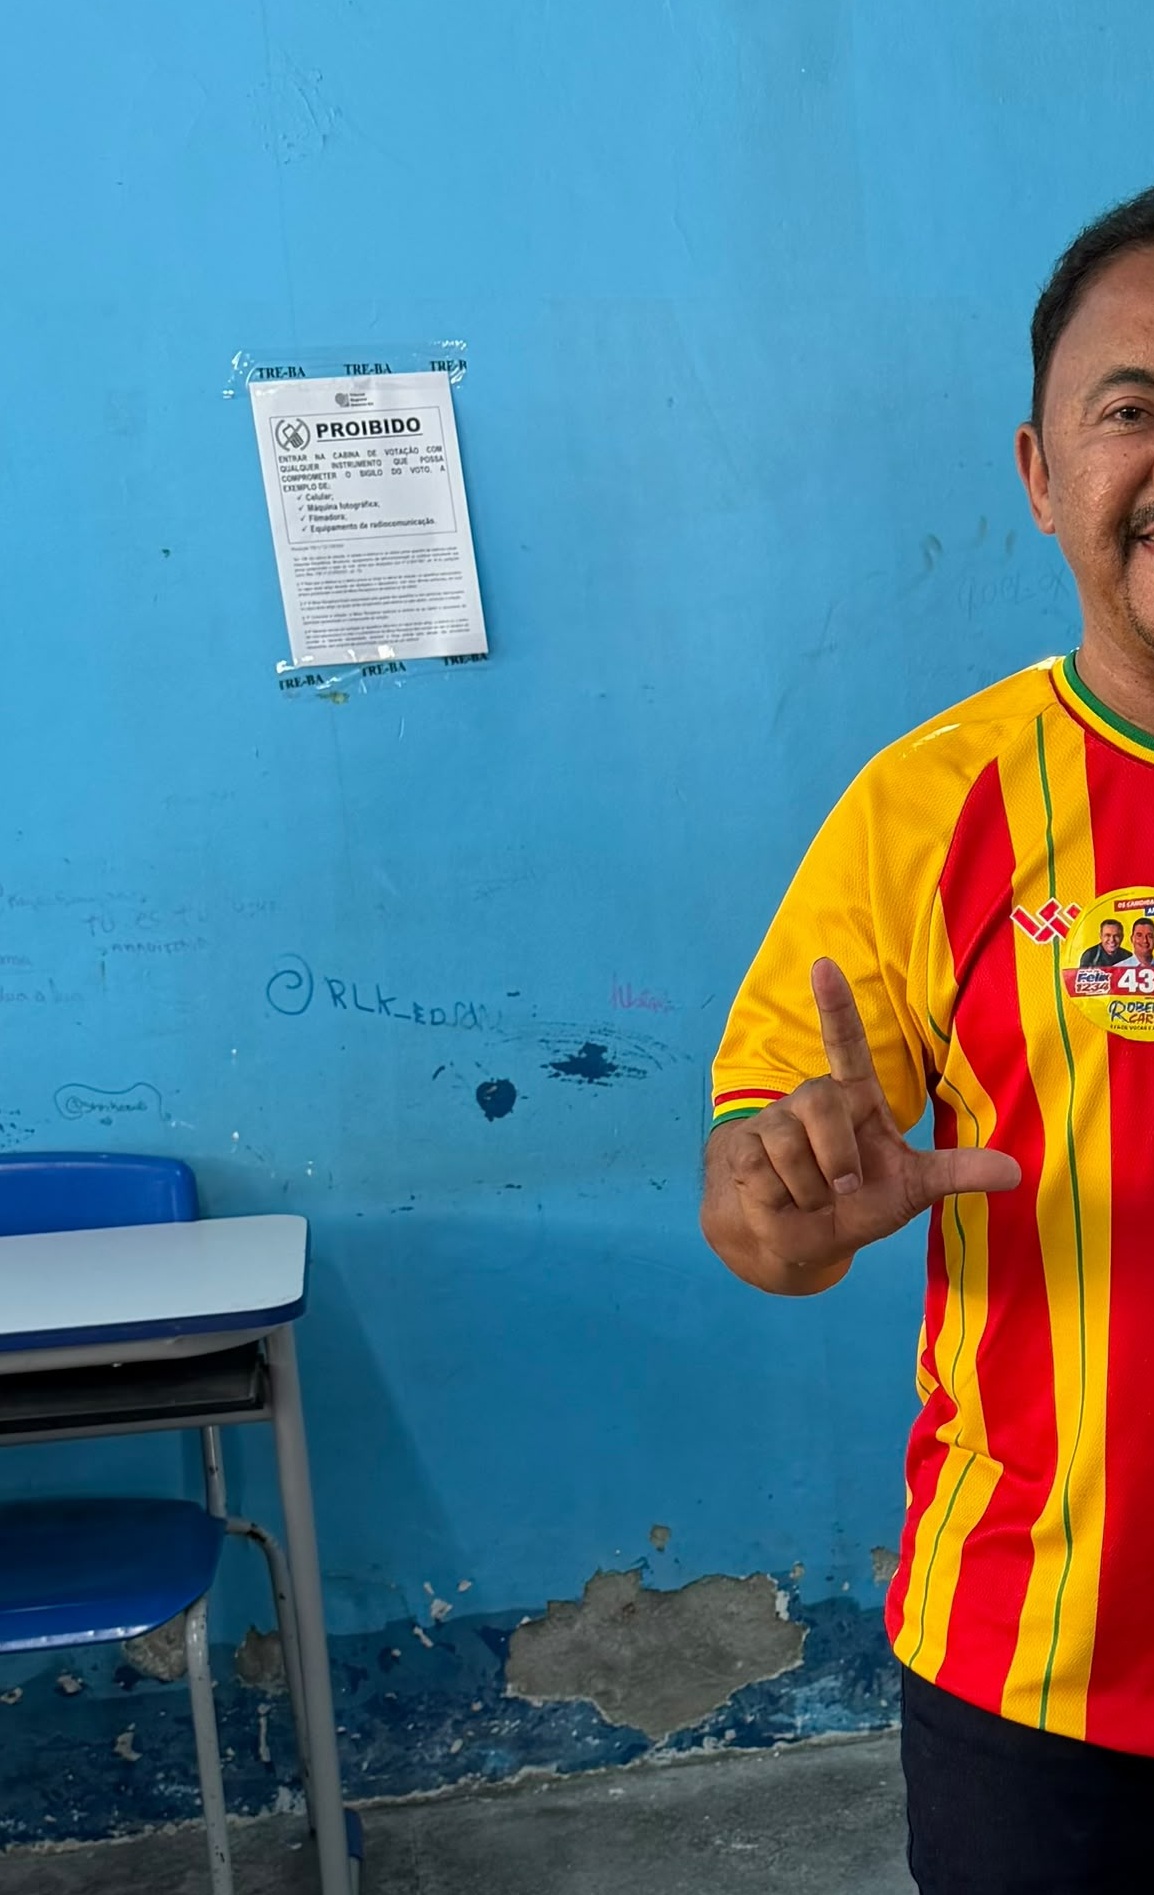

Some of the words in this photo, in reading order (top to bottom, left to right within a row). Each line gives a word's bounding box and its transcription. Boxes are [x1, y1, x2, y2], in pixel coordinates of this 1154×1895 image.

[257, 366, 306, 379] TRE-BA
[343, 363, 392, 376] TRE-BA
[316, 416, 421, 439] PROIBIDO
[278, 454, 307, 463] ENTRAR
[333, 451, 360, 459] CABINA
[367, 449, 377, 457] DE
[384, 446, 419, 456] VOTAÇÃO
[280, 463, 319, 473] QUALQUER
[331, 459, 382, 469] INSTRUMENTO
[393, 457, 408, 465] QUE
[420, 455, 444, 463] POSSA
[281, 472, 337, 483] COMPROMETER
[360, 469, 383, 477] SIGILO
[391, 467, 402, 475] DO
[283, 483, 317, 492] EXEMPLO
[307, 504, 338, 512] Máquina
[310, 523, 358, 533] Equipamento
[361, 661, 407, 677] TRE-BA
[279, 674, 325, 690] TRE-BA
[1076, 983, 1109, 992] 1234
